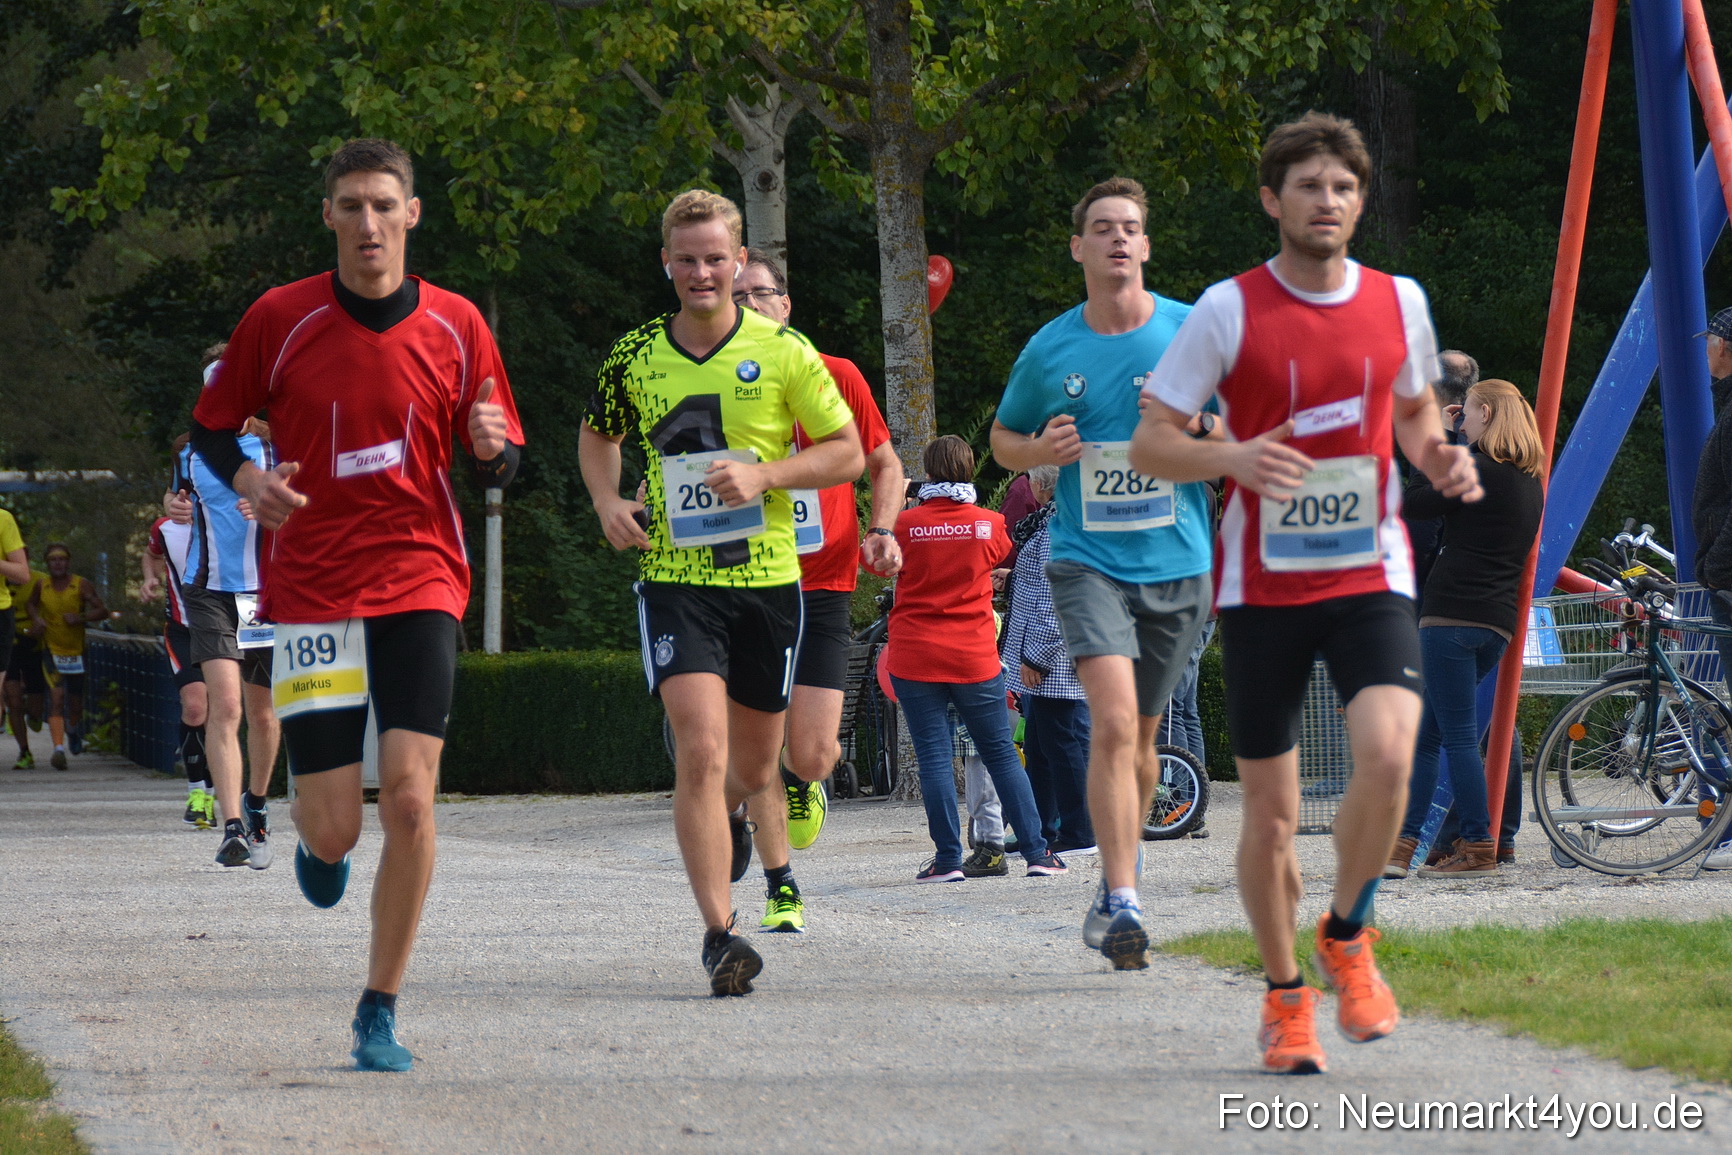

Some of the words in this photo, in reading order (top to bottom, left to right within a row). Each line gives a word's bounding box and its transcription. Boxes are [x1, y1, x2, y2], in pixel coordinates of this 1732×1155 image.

[735, 386, 762, 396] Partl
[1312, 409, 1344, 424] DEHN
[355, 451, 386, 467] DEHN
[1094, 469, 1159, 496] 2282
[1106, 503, 1150, 516] Bernhard
[1280, 491, 1360, 527] 2092
[702, 517, 731, 529] Robin
[909, 522, 972, 538] raumbox
[1302, 538, 1340, 550] Tobias
[284, 632, 337, 671] 189
[292, 678, 332, 694] Markus
